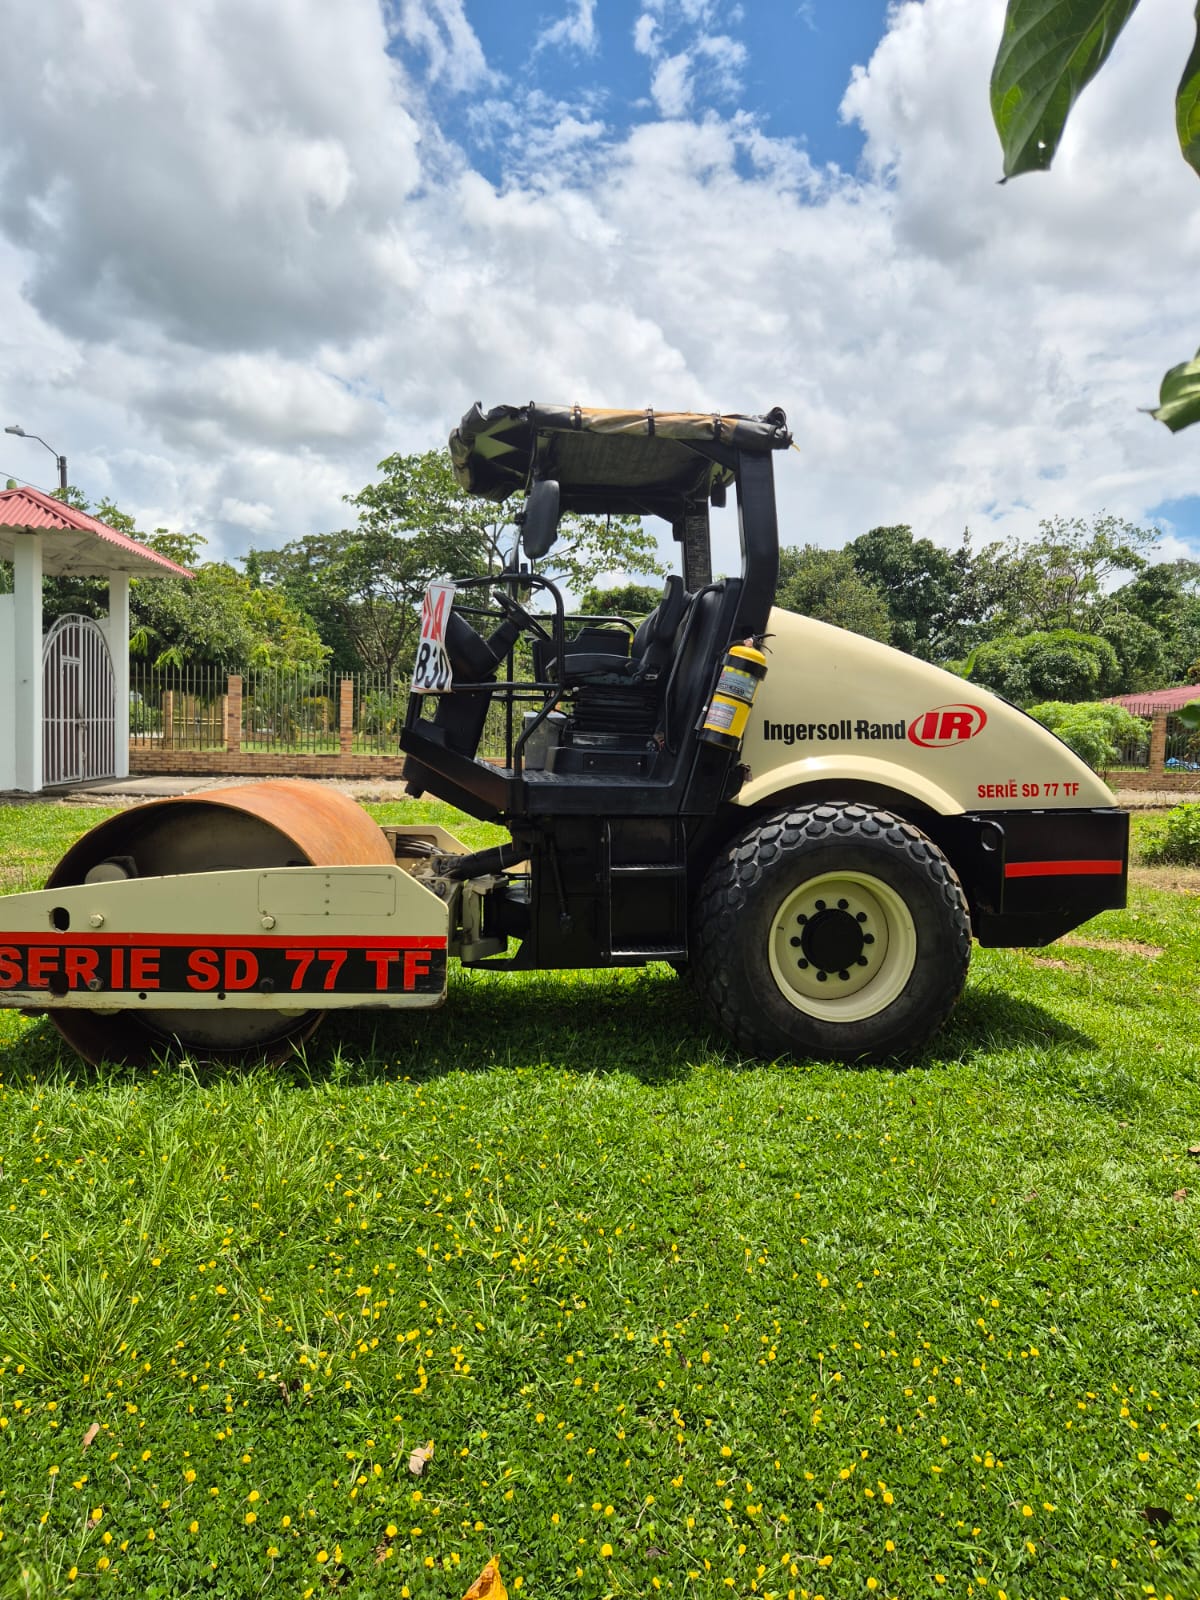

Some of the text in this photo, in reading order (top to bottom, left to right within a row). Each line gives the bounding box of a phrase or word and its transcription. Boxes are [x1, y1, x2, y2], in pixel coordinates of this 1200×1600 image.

[921, 712, 974, 740] IR
[977, 782, 1080, 798] SERIE SD 77 TF
[0, 946, 431, 991] SERIE SD 77 TF
